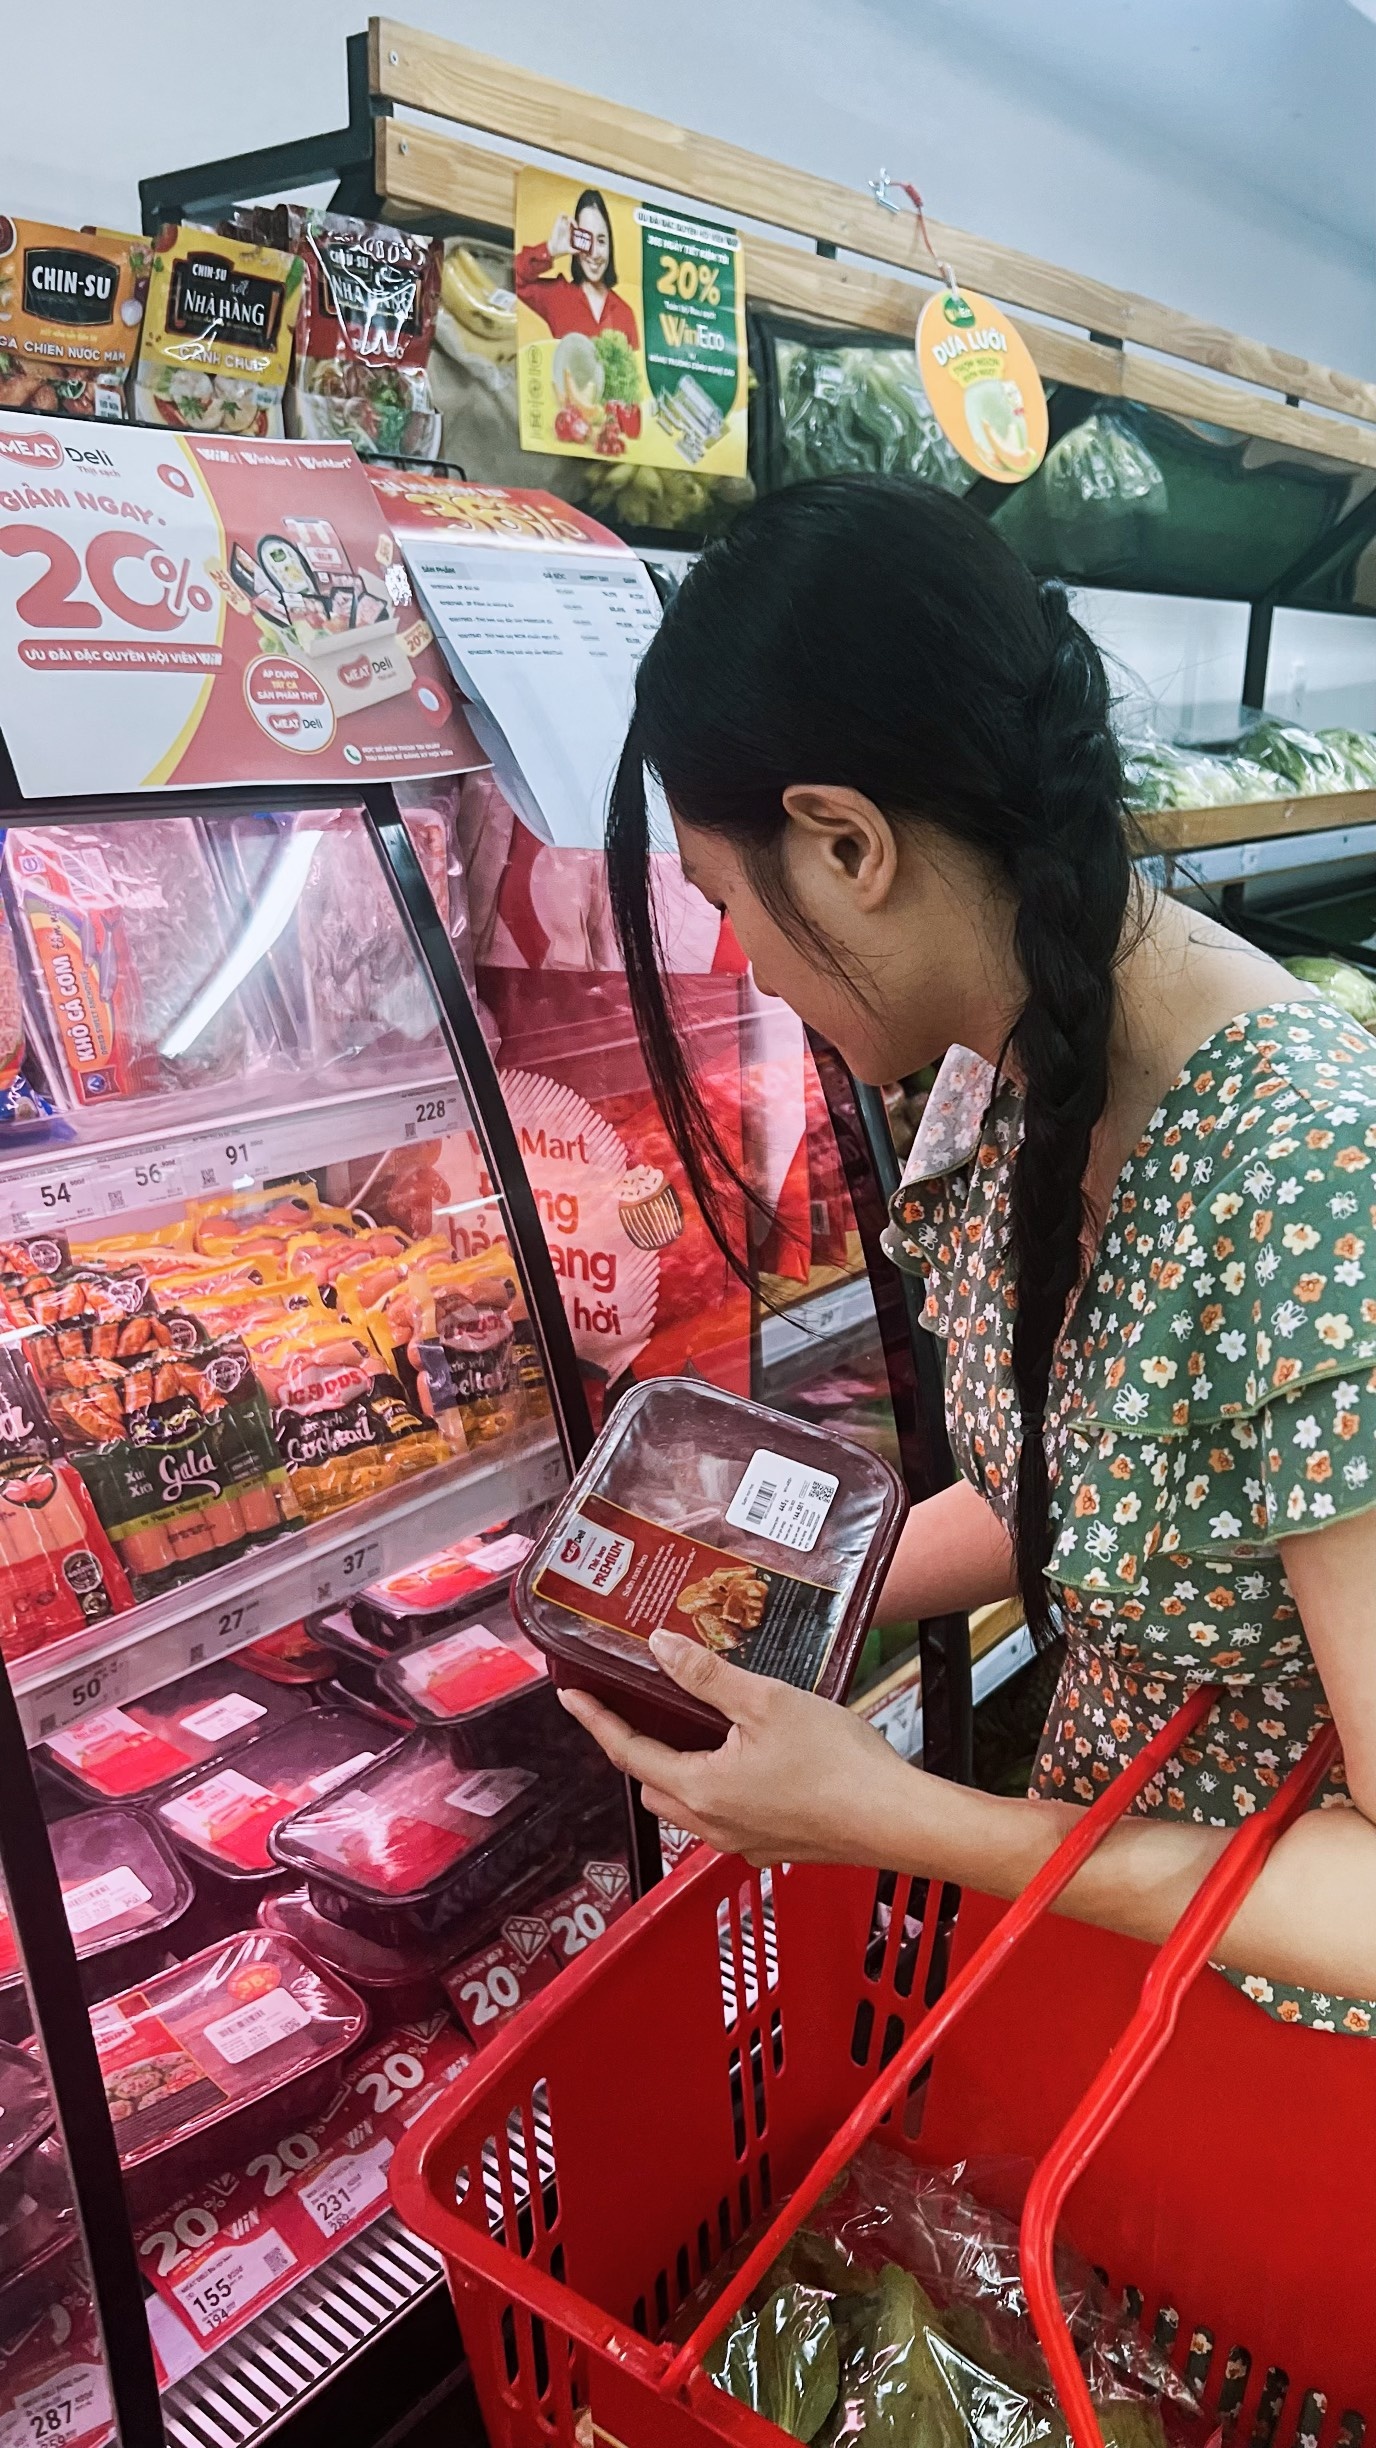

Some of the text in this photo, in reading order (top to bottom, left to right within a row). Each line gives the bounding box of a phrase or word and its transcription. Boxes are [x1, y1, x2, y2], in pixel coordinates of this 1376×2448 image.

[31, 265, 112, 300] CHIN-SU
[192, 263, 228, 281] CHIN-SU
[656, 255, 722, 306] 20%
[184, 289, 216, 316] NHÀ
[220, 296, 265, 326] HÀNG
[659, 312, 725, 352] WinEco
[0, 439, 114, 467] MEAT Deli
[0, 482, 154, 525] GIẢM NGAY
[0, 523, 213, 632] 20%
[343, 665, 370, 684] MEAT
[371, 656, 393, 674] Deli
[271, 717, 323, 730] MEAT Deli
[52, 954, 97, 1063] KHÔ CÁ CƠM
[416, 1100, 446, 1123] 228
[225, 1143, 249, 1165] 91
[134, 1163, 162, 1186] 56
[40, 1182, 72, 1207] 54
[574, 1296, 622, 1336] hời
[287, 1416, 376, 1462] Cocktail
[159, 1449, 222, 1502] Gala
[574, 1529, 587, 1543] Deli
[343, 1548, 366, 1575] 37
[592, 1539, 626, 1588] PREMIUM
[218, 1608, 244, 1637] 27
[72, 1679, 101, 1706] 50
[316, 2187, 351, 2221] 231
[192, 2278, 232, 2314] 155
[30, 2400, 71, 2439] 287
